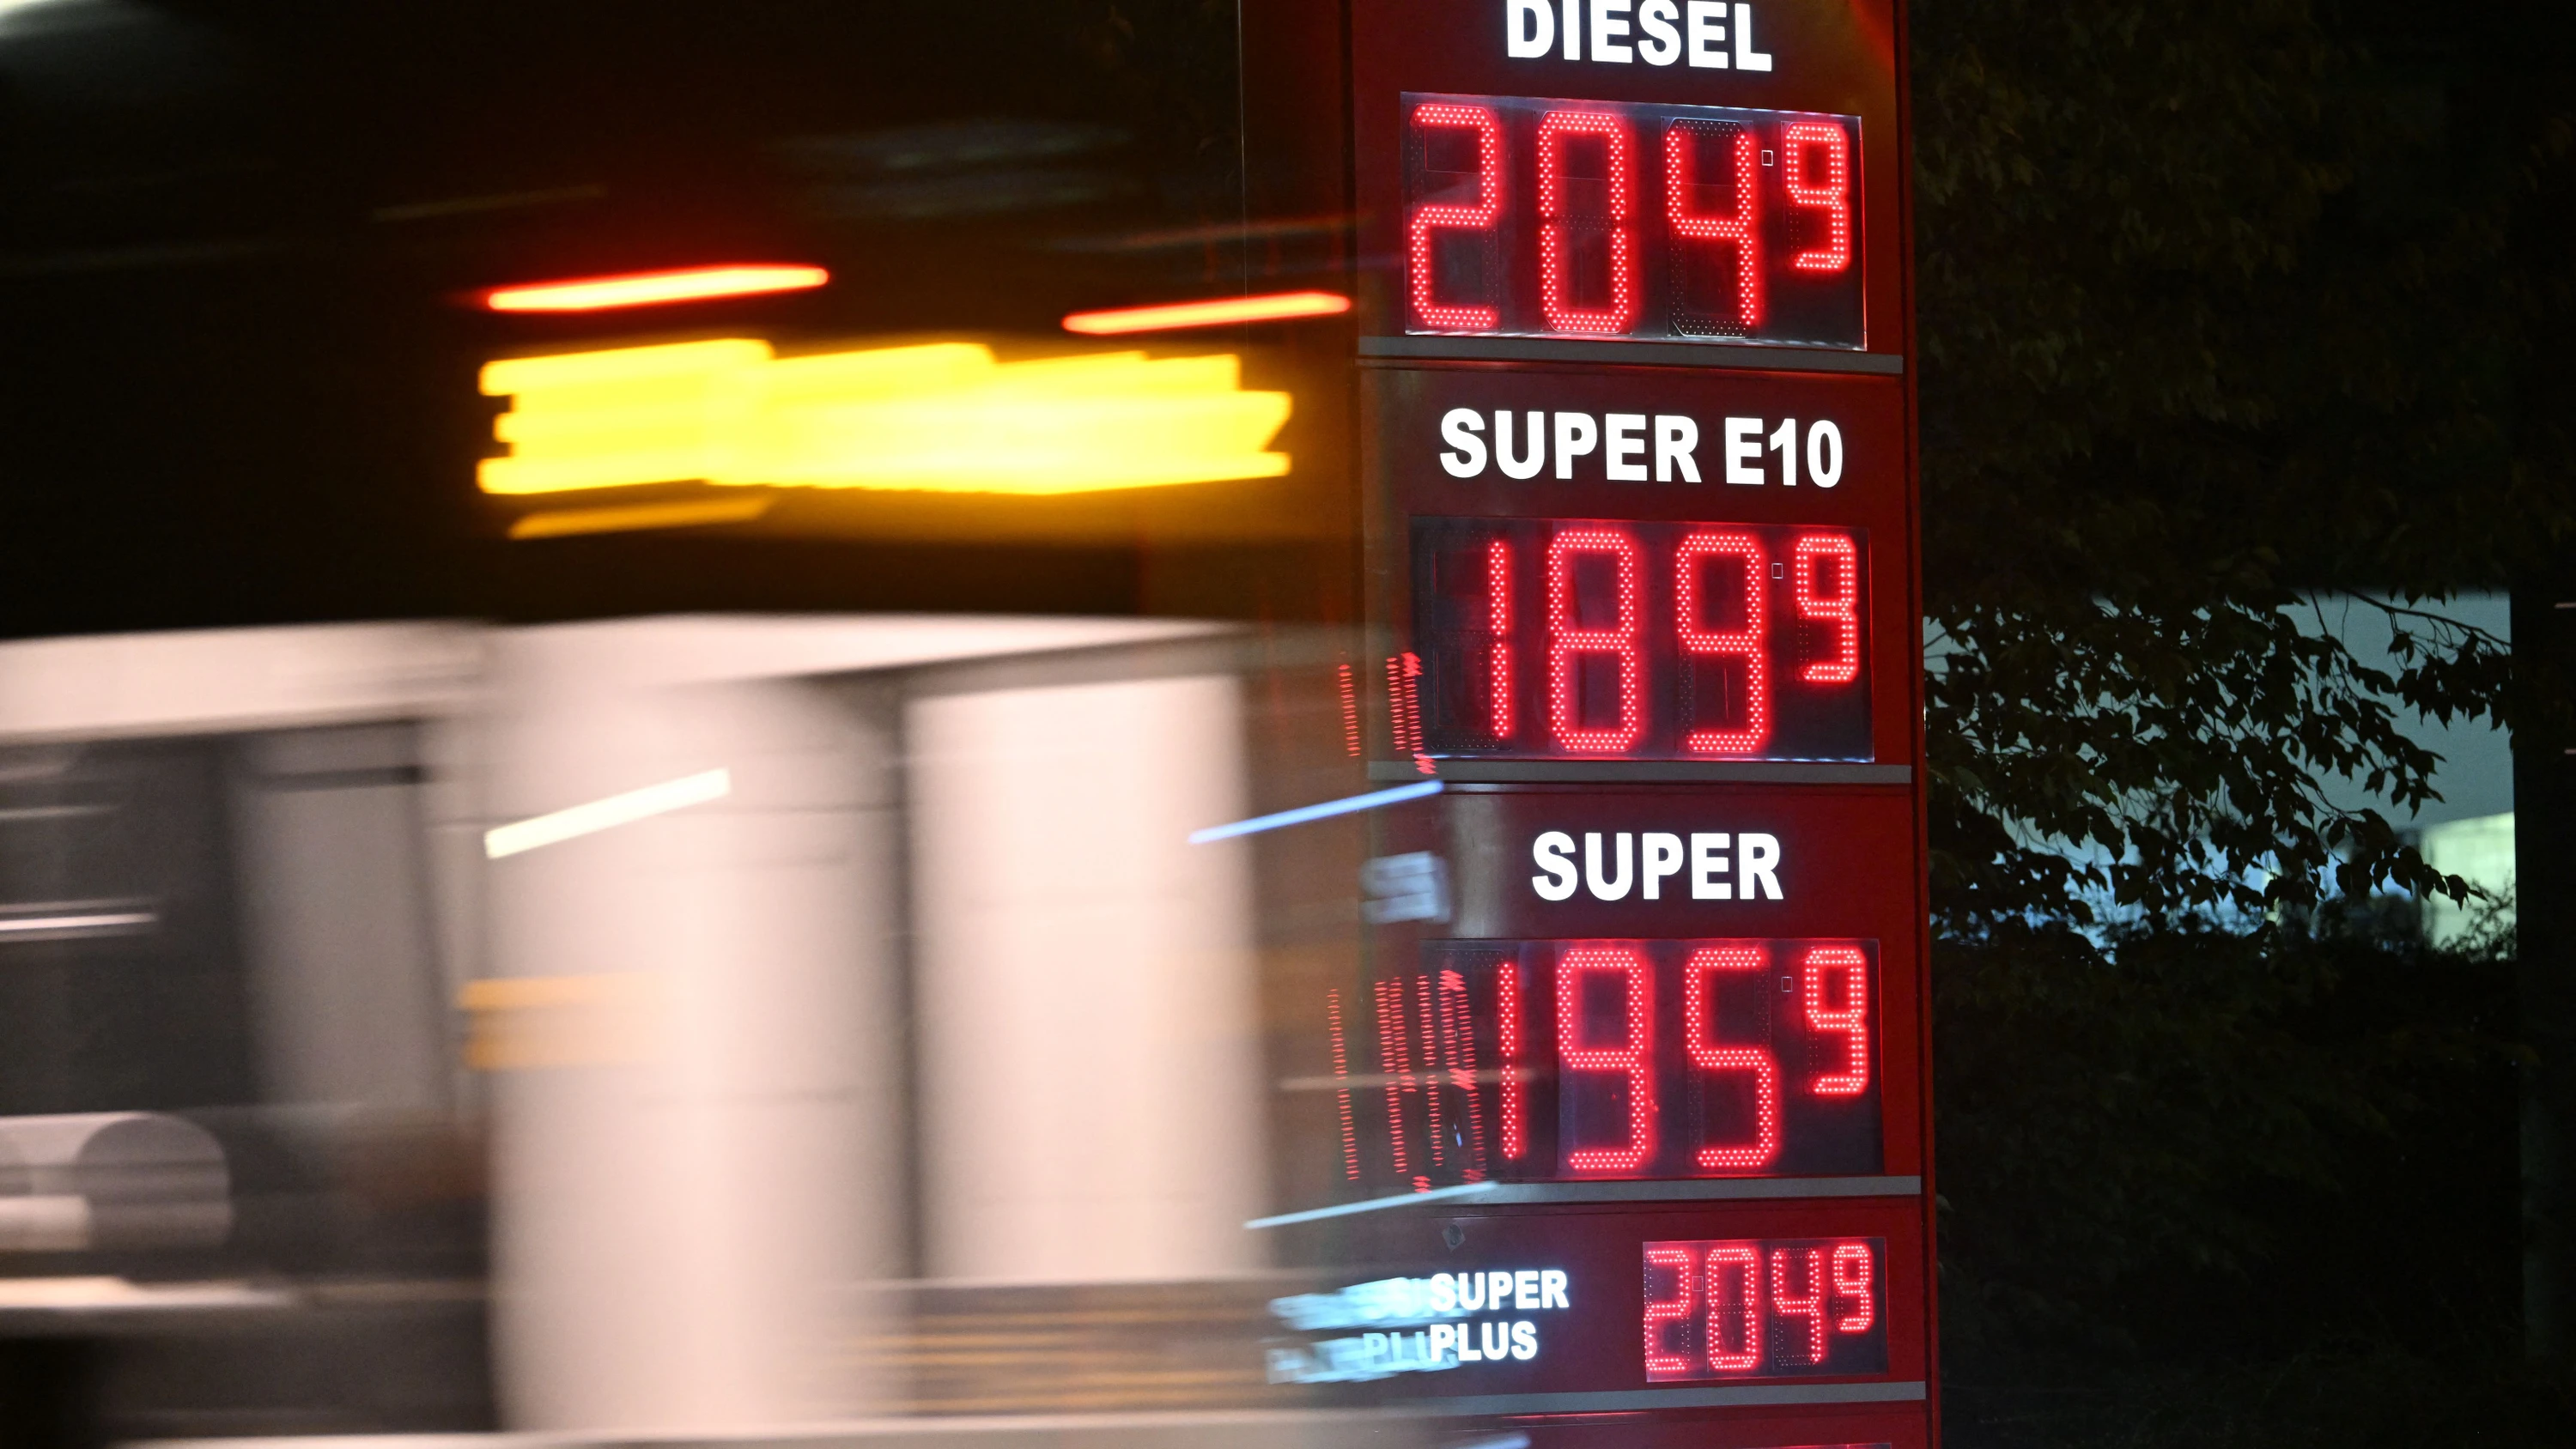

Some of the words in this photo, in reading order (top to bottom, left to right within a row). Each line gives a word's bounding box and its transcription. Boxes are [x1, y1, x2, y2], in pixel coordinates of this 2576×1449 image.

[1506, 0, 1773, 72] DIESEL
[1439, 408, 1703, 482] SUPER
[1724, 416, 1844, 488] E10
[1532, 831, 1784, 901] SUPER
[1429, 1270, 1571, 1312] SUPER
[1429, 1320, 1538, 1362] PLUS
